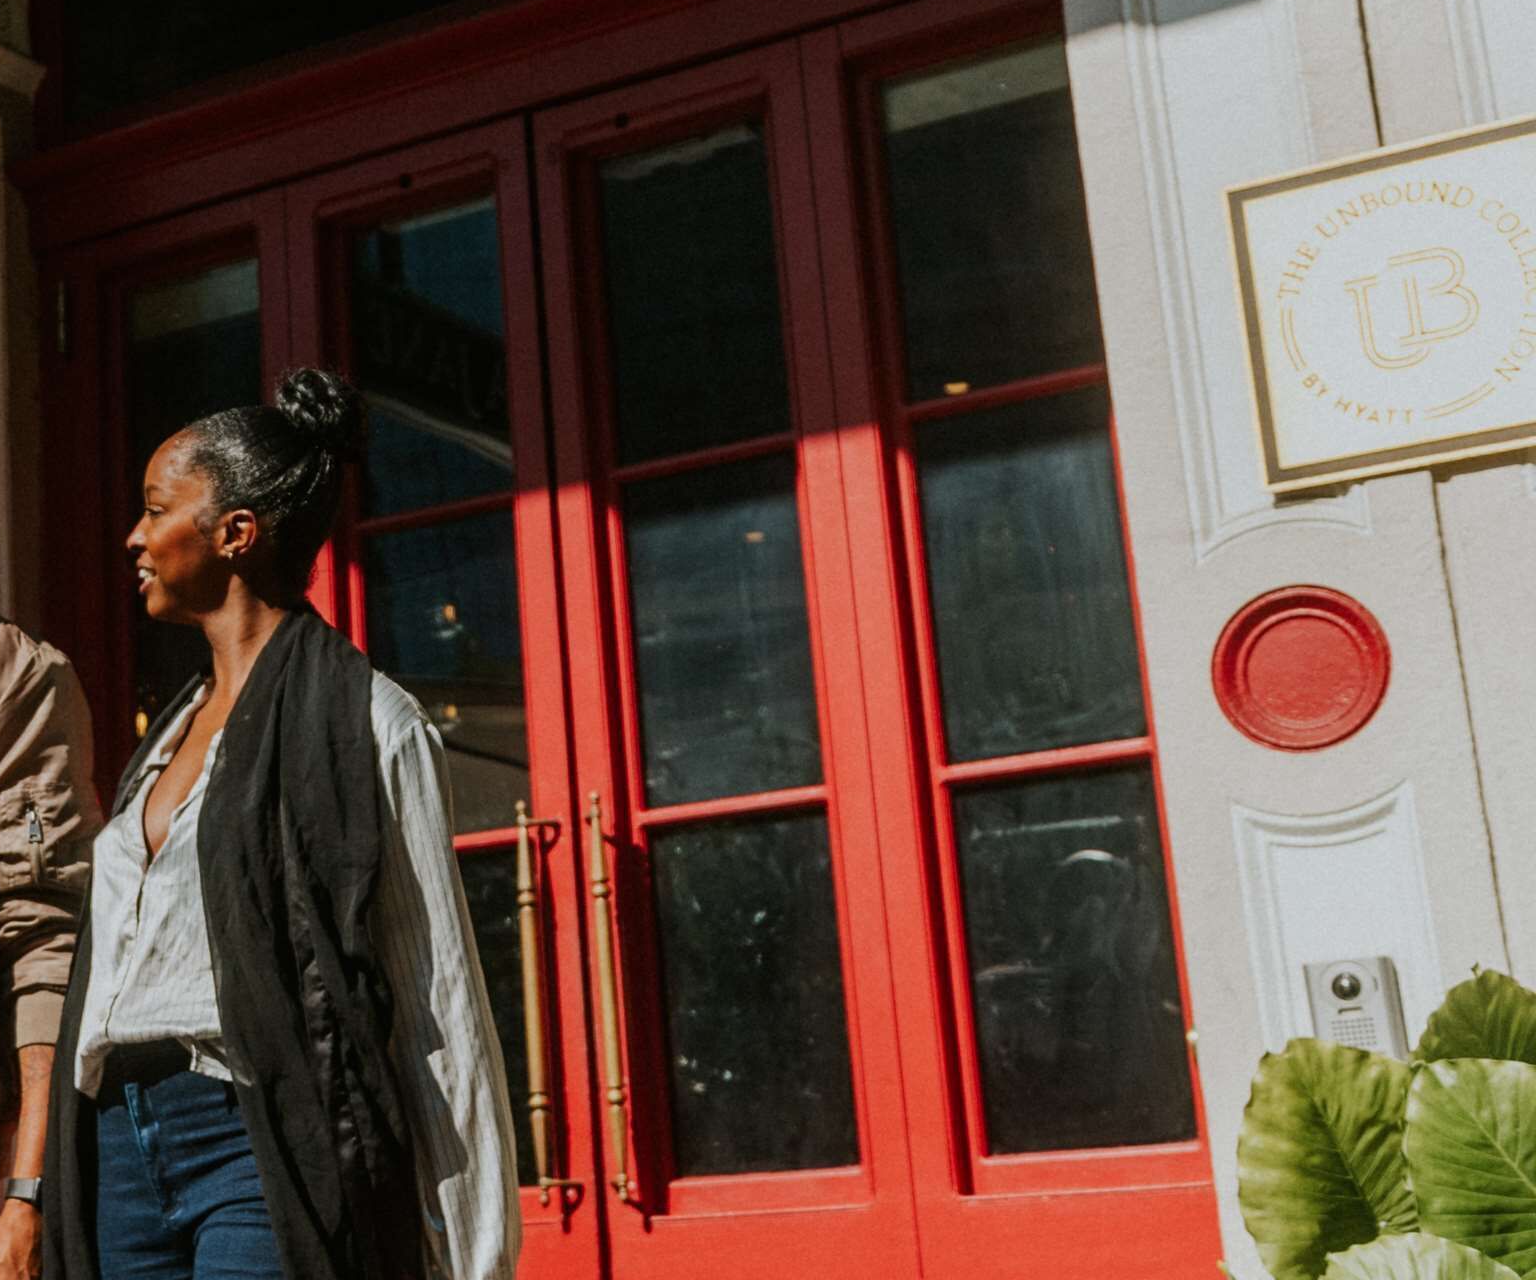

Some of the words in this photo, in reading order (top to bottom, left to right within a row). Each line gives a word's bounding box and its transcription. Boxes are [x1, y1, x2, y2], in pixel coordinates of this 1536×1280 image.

[1276, 241, 1321, 300] THE
[1315, 180, 1475, 240] UNBOUND
[1301, 372, 1329, 398] BY
[1333, 394, 1413, 423] HYATT
